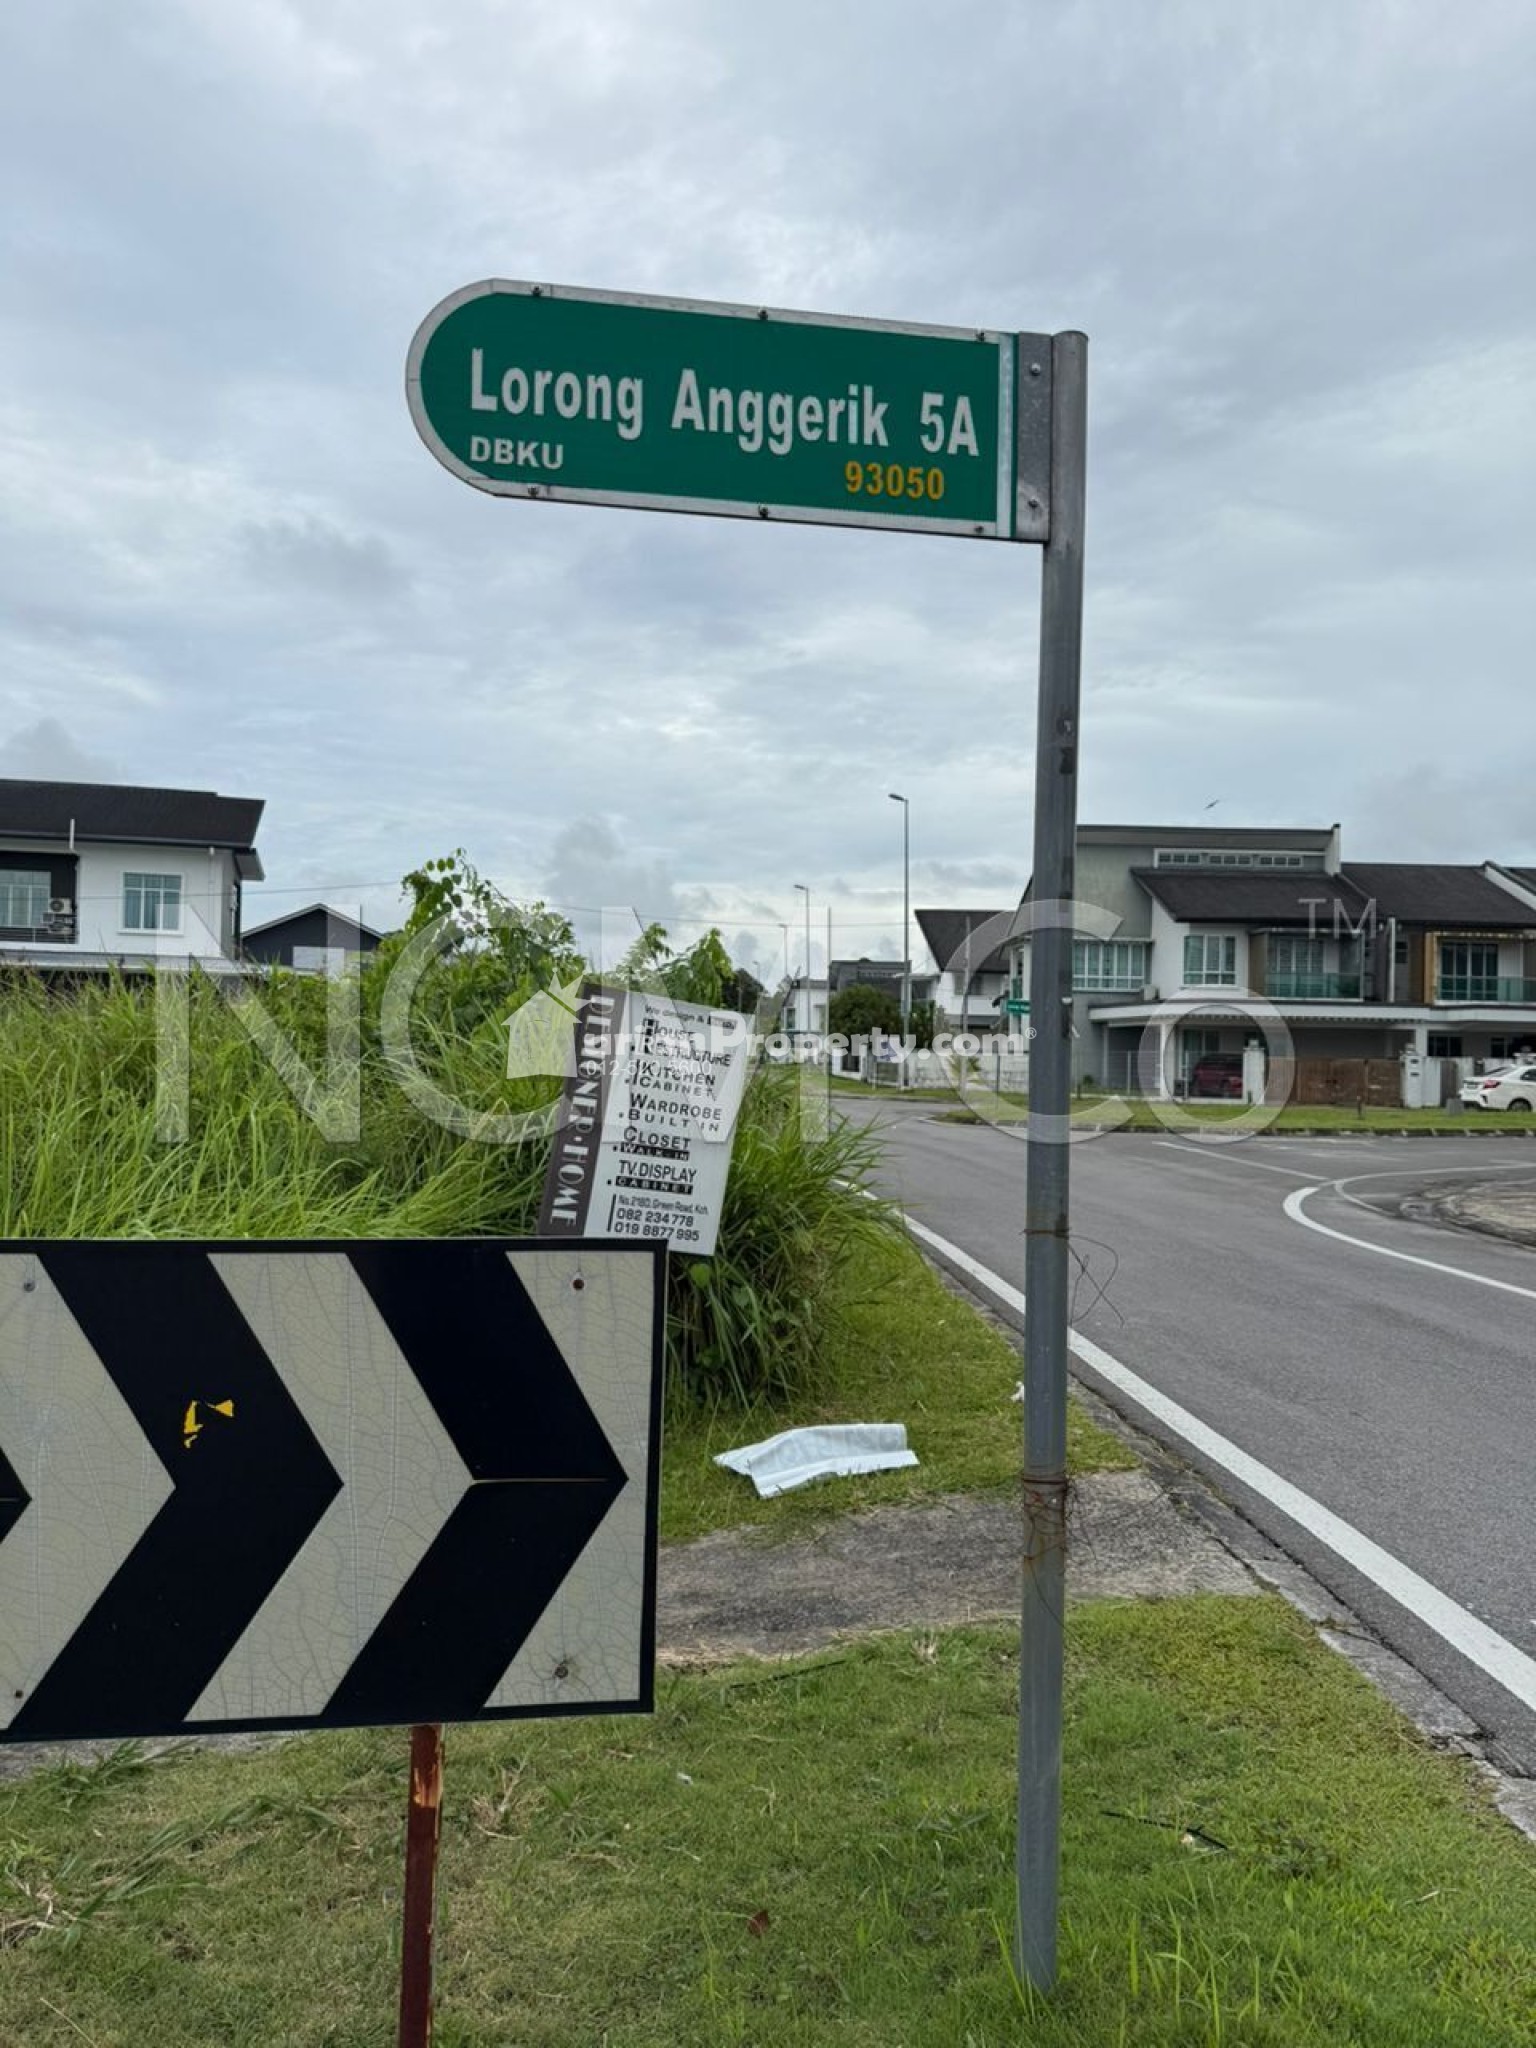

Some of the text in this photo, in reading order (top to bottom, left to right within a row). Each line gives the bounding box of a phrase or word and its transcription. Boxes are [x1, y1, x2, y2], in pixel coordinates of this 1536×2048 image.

[470, 347, 980, 457] Lorong Anggerik 5A
[470, 434, 565, 470] DBKU
[845, 460, 945, 499] 93050
[628, 1108, 719, 1132] BUILT IN
[629, 1092, 722, 1121] WARDROBE
[623, 1125, 692, 1150] CLOSET
[550, 1144, 590, 1227] HOME
